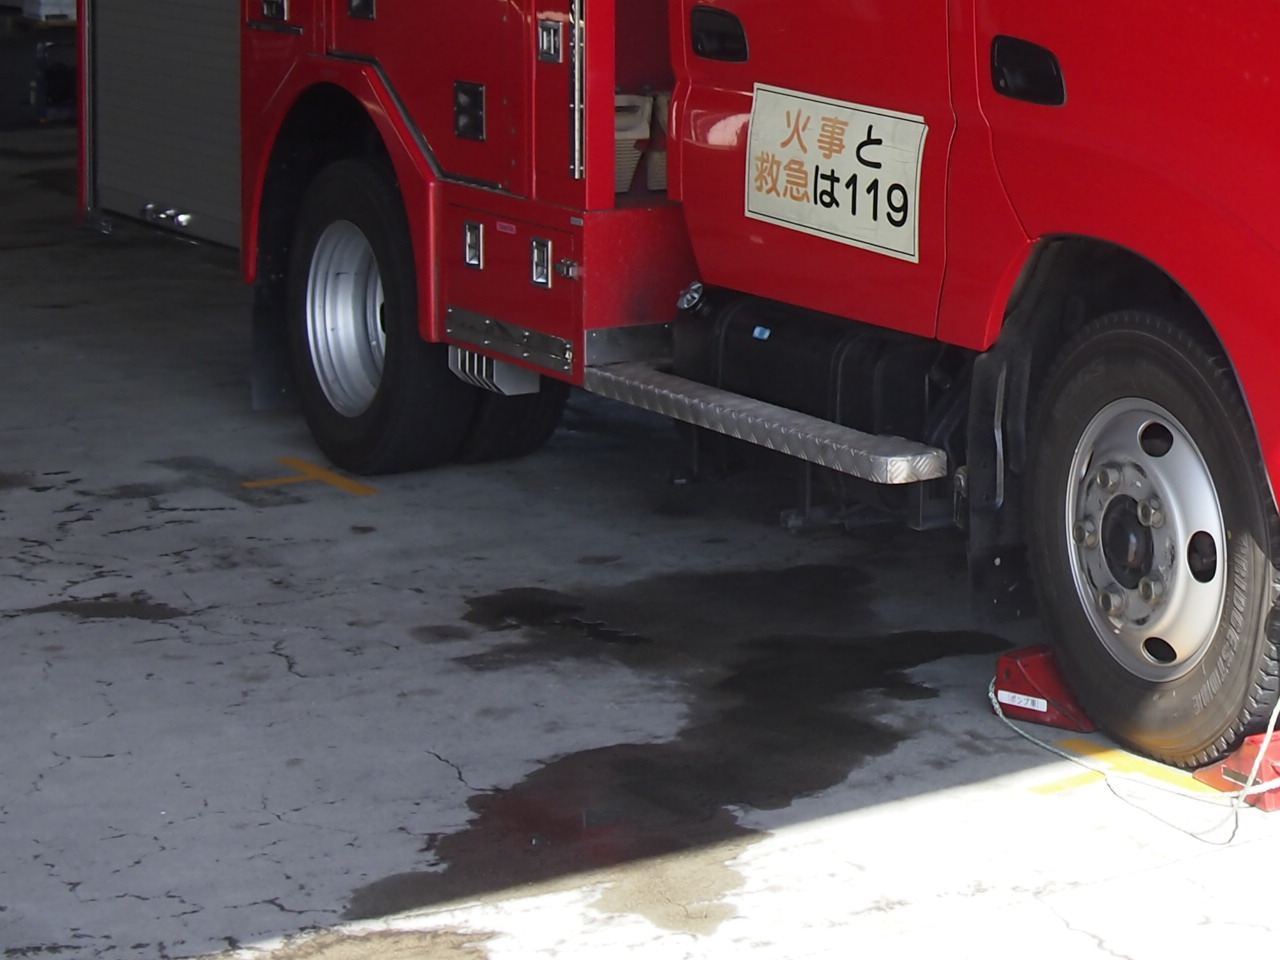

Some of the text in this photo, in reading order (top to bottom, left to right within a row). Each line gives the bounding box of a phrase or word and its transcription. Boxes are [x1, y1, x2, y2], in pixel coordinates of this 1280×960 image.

[780, 108, 883, 169] 火事と
[754, 151, 908, 228] 救急は119
